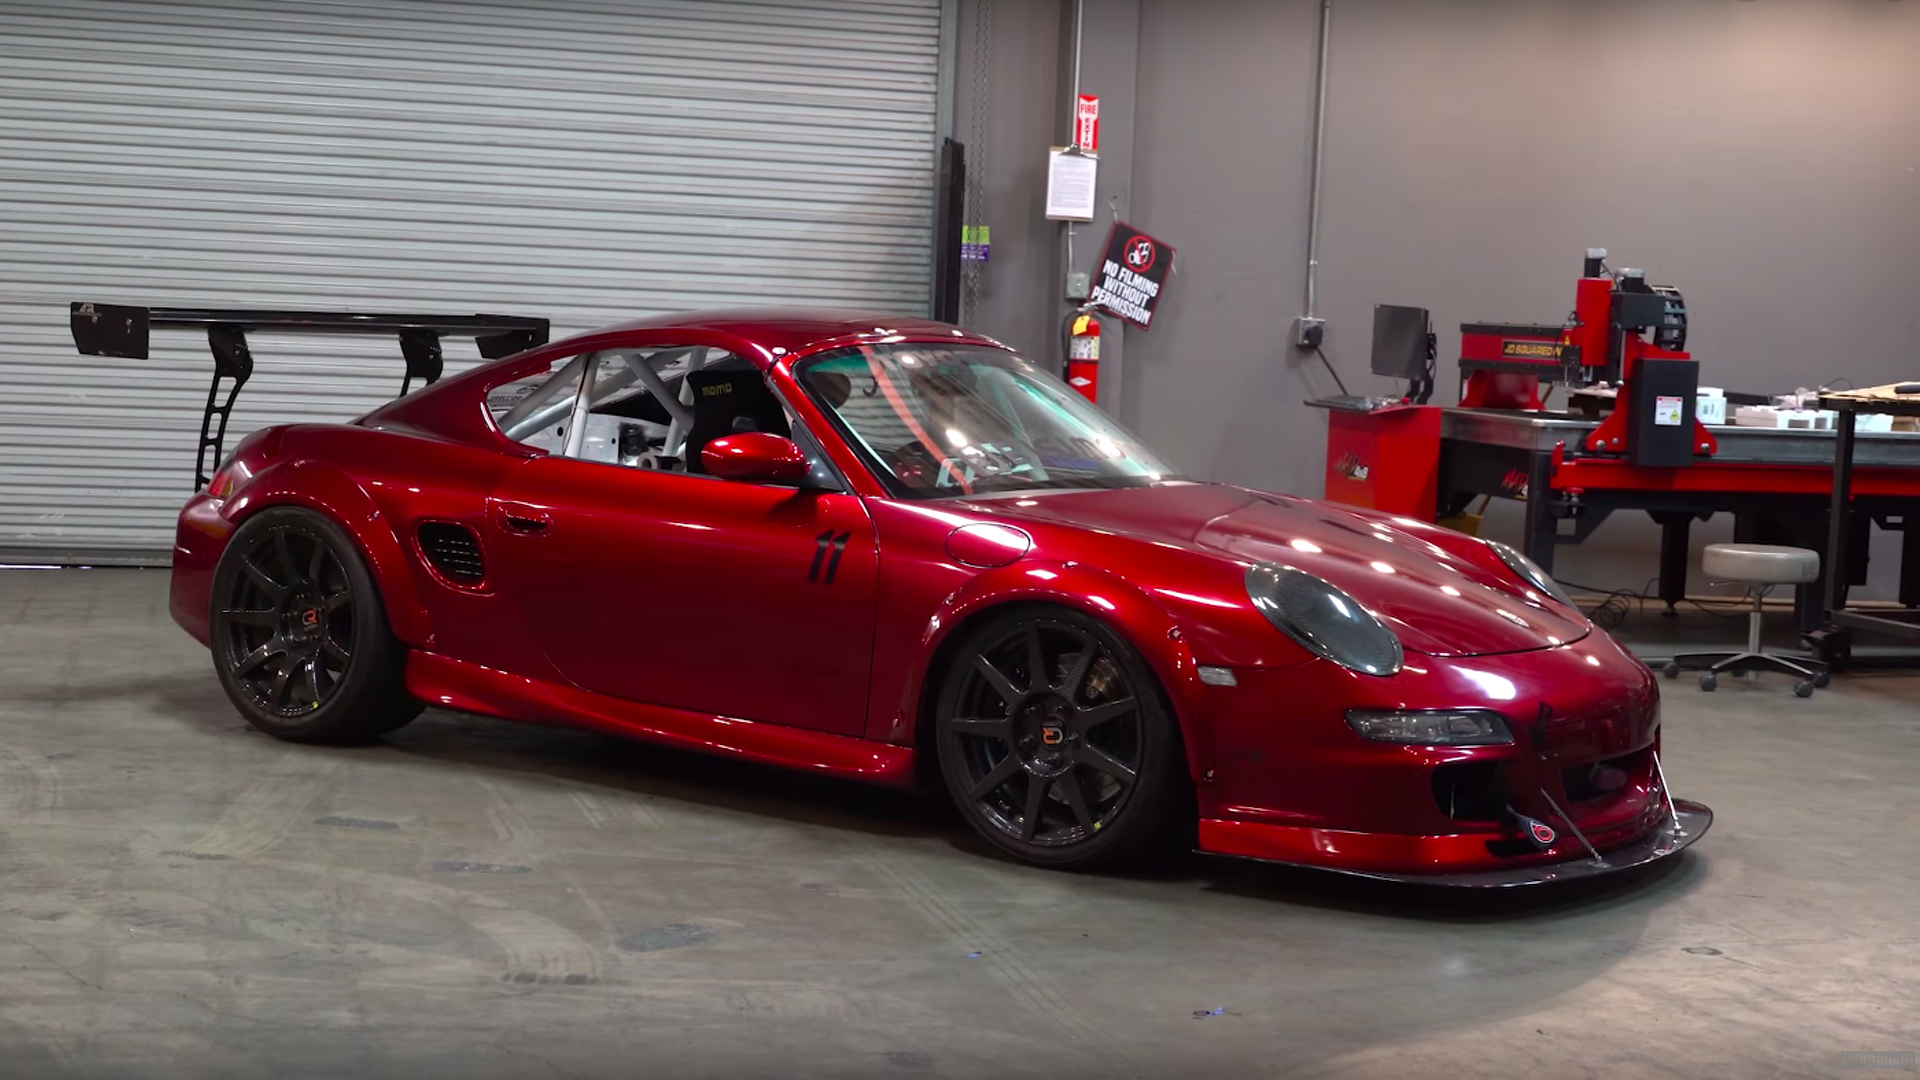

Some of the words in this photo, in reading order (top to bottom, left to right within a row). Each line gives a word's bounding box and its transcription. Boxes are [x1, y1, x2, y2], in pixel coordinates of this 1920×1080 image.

[1081, 104, 1096, 114] FIRE
[1103, 259, 1119, 277] NO
[1118, 267, 1159, 297] FILMING
[1103, 276, 1149, 307] WITHOUT
[1091, 285, 1151, 325] PERMISSION
[1515, 345, 1553, 356] SQUARED
[809, 529, 851, 584] 11
